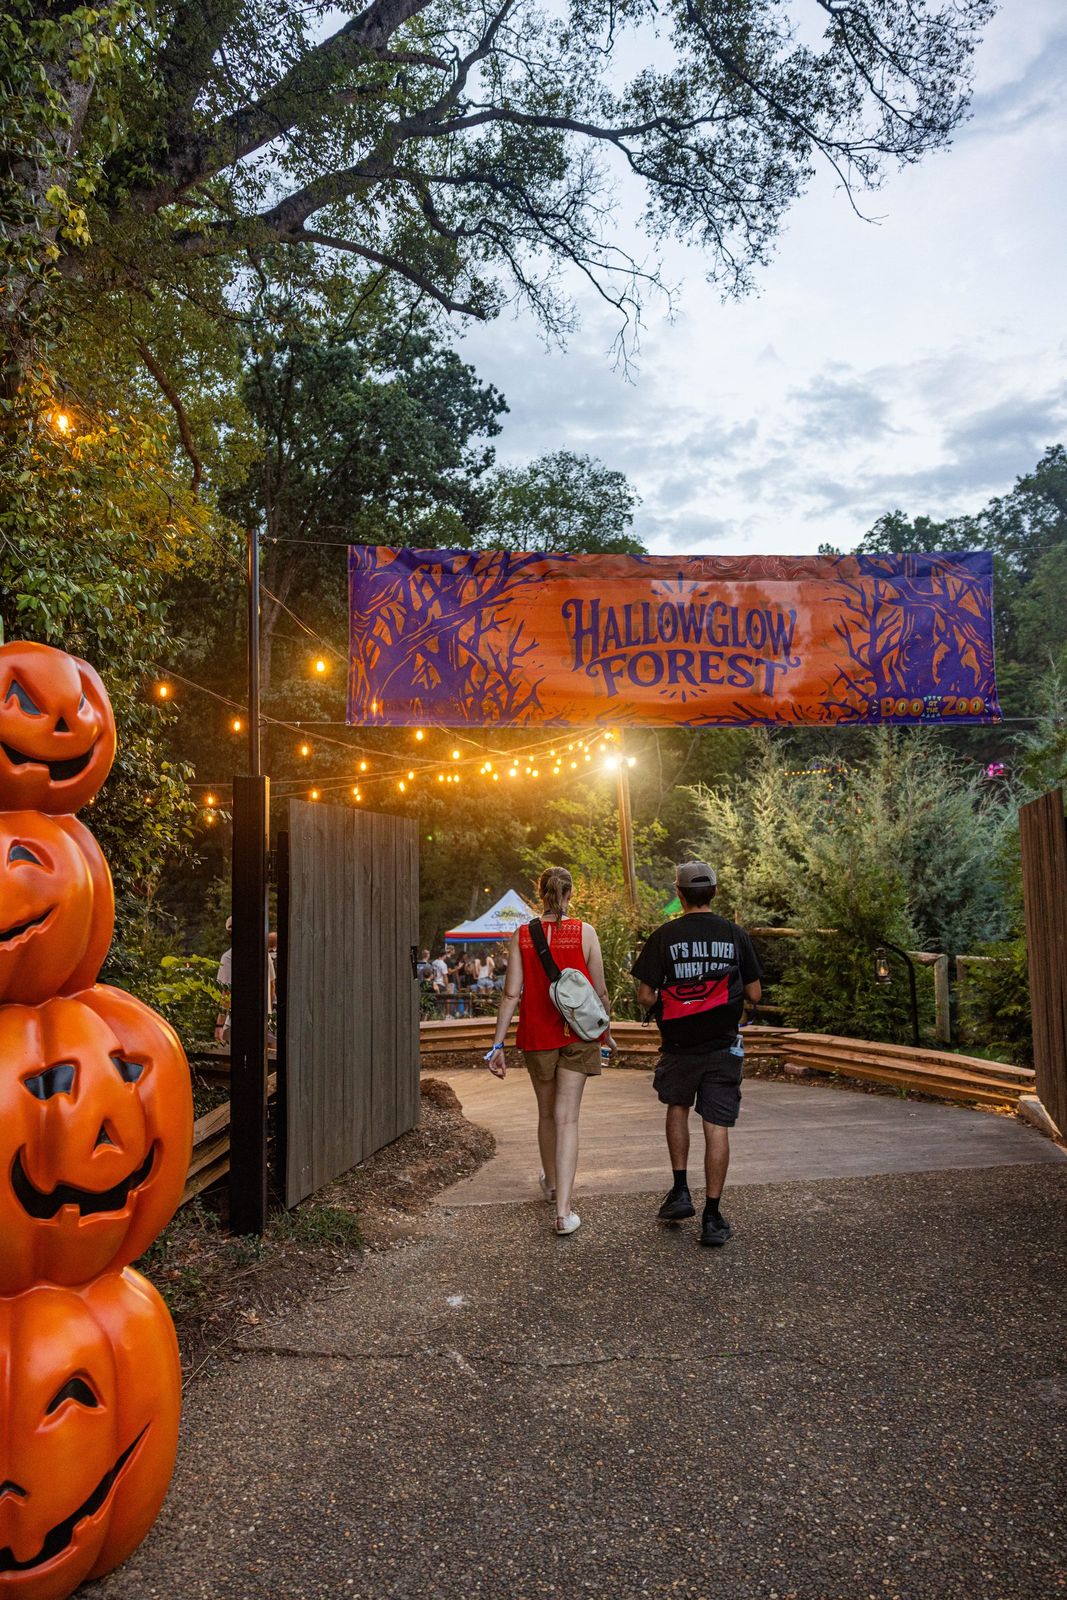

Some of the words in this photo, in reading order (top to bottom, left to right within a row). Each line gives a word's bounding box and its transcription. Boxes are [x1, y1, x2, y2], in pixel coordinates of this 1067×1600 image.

[562, 598, 801, 672] HALLOWGLOW
[587, 649, 788, 698] FOREST
[880, 697, 924, 717] BOO
[943, 695, 984, 715] ZOO
[669, 942, 689, 960] IT'S
[692, 941, 709, 957] ALL
[711, 941, 735, 959] OVER
[673, 962, 704, 978] WHEN
